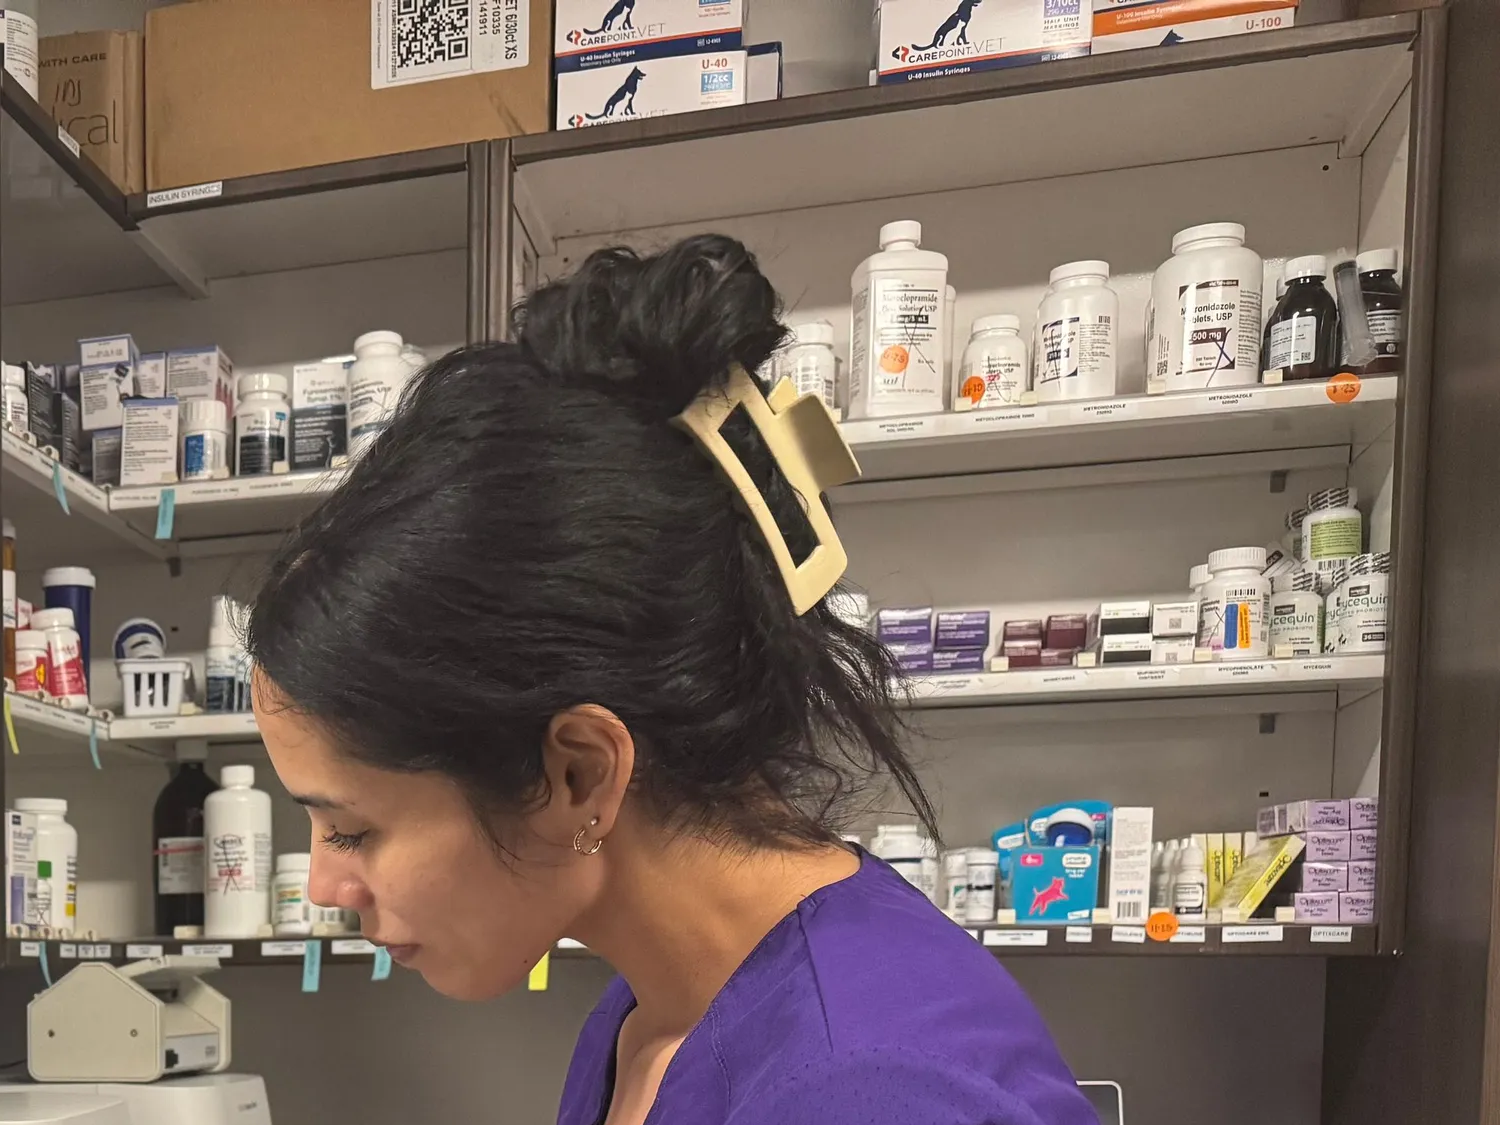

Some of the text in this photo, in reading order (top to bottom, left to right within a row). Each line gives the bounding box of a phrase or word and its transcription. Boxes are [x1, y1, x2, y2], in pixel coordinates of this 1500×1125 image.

[1246, 17, 1282, 30] U-100
[72, 53, 108, 64] CARE
[505, 46, 518, 60] XS
[702, 58, 728, 70] U-40
[1216, 312, 1233, 321] USP
